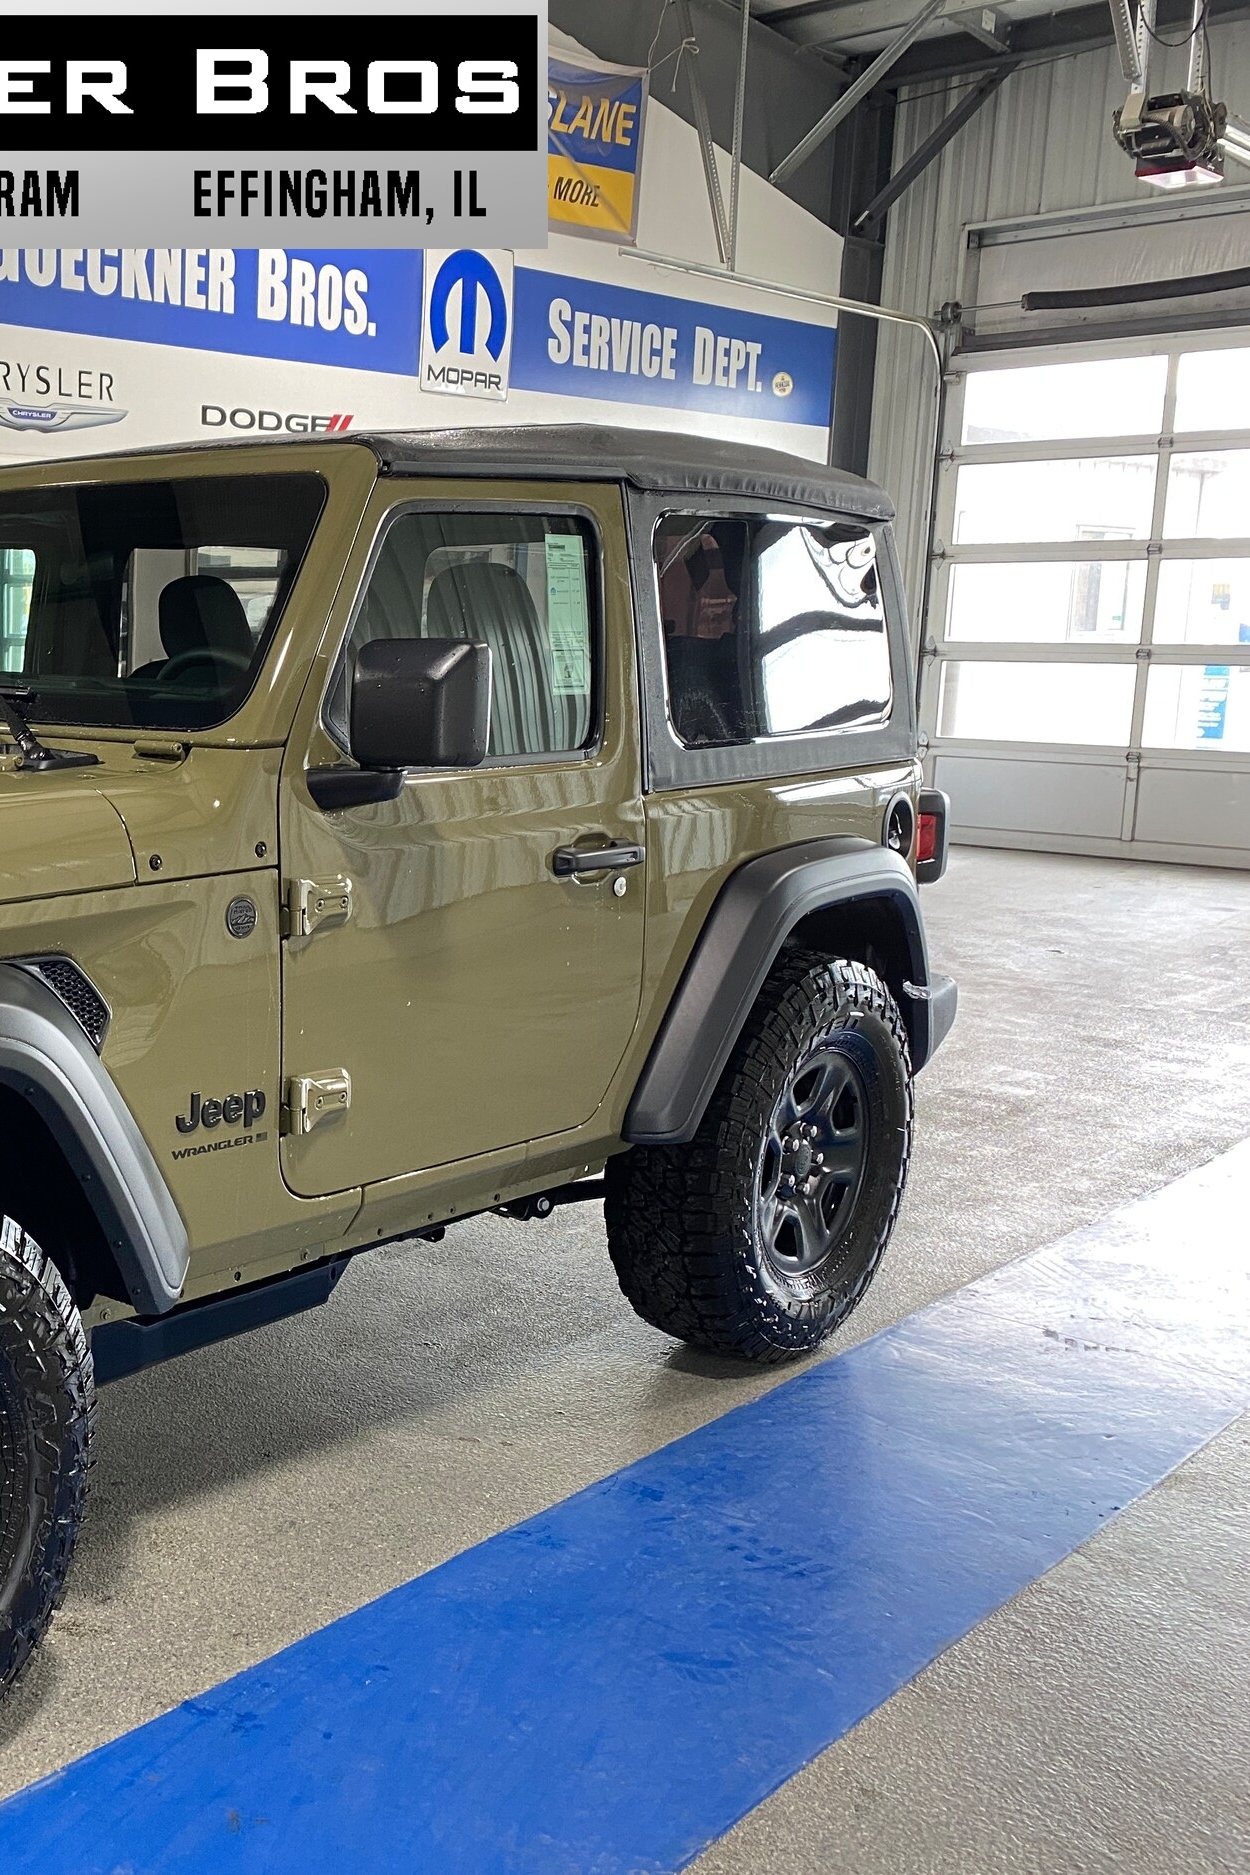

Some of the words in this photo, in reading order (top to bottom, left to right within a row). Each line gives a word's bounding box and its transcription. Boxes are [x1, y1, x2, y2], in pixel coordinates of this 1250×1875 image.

[553, 176, 601, 207] MORE
[257, 249, 377, 337] BROS.
[547, 297, 678, 380] SERVICE
[692, 326, 763, 393] DEPT.
[427, 364, 502, 391] MOPAR
[12, 409, 52, 419] CHRYSLER
[201, 404, 333, 433] DODGE
[175, 1088, 266, 1134] Jeep
[171, 1135, 254, 1160] WRANGLER
